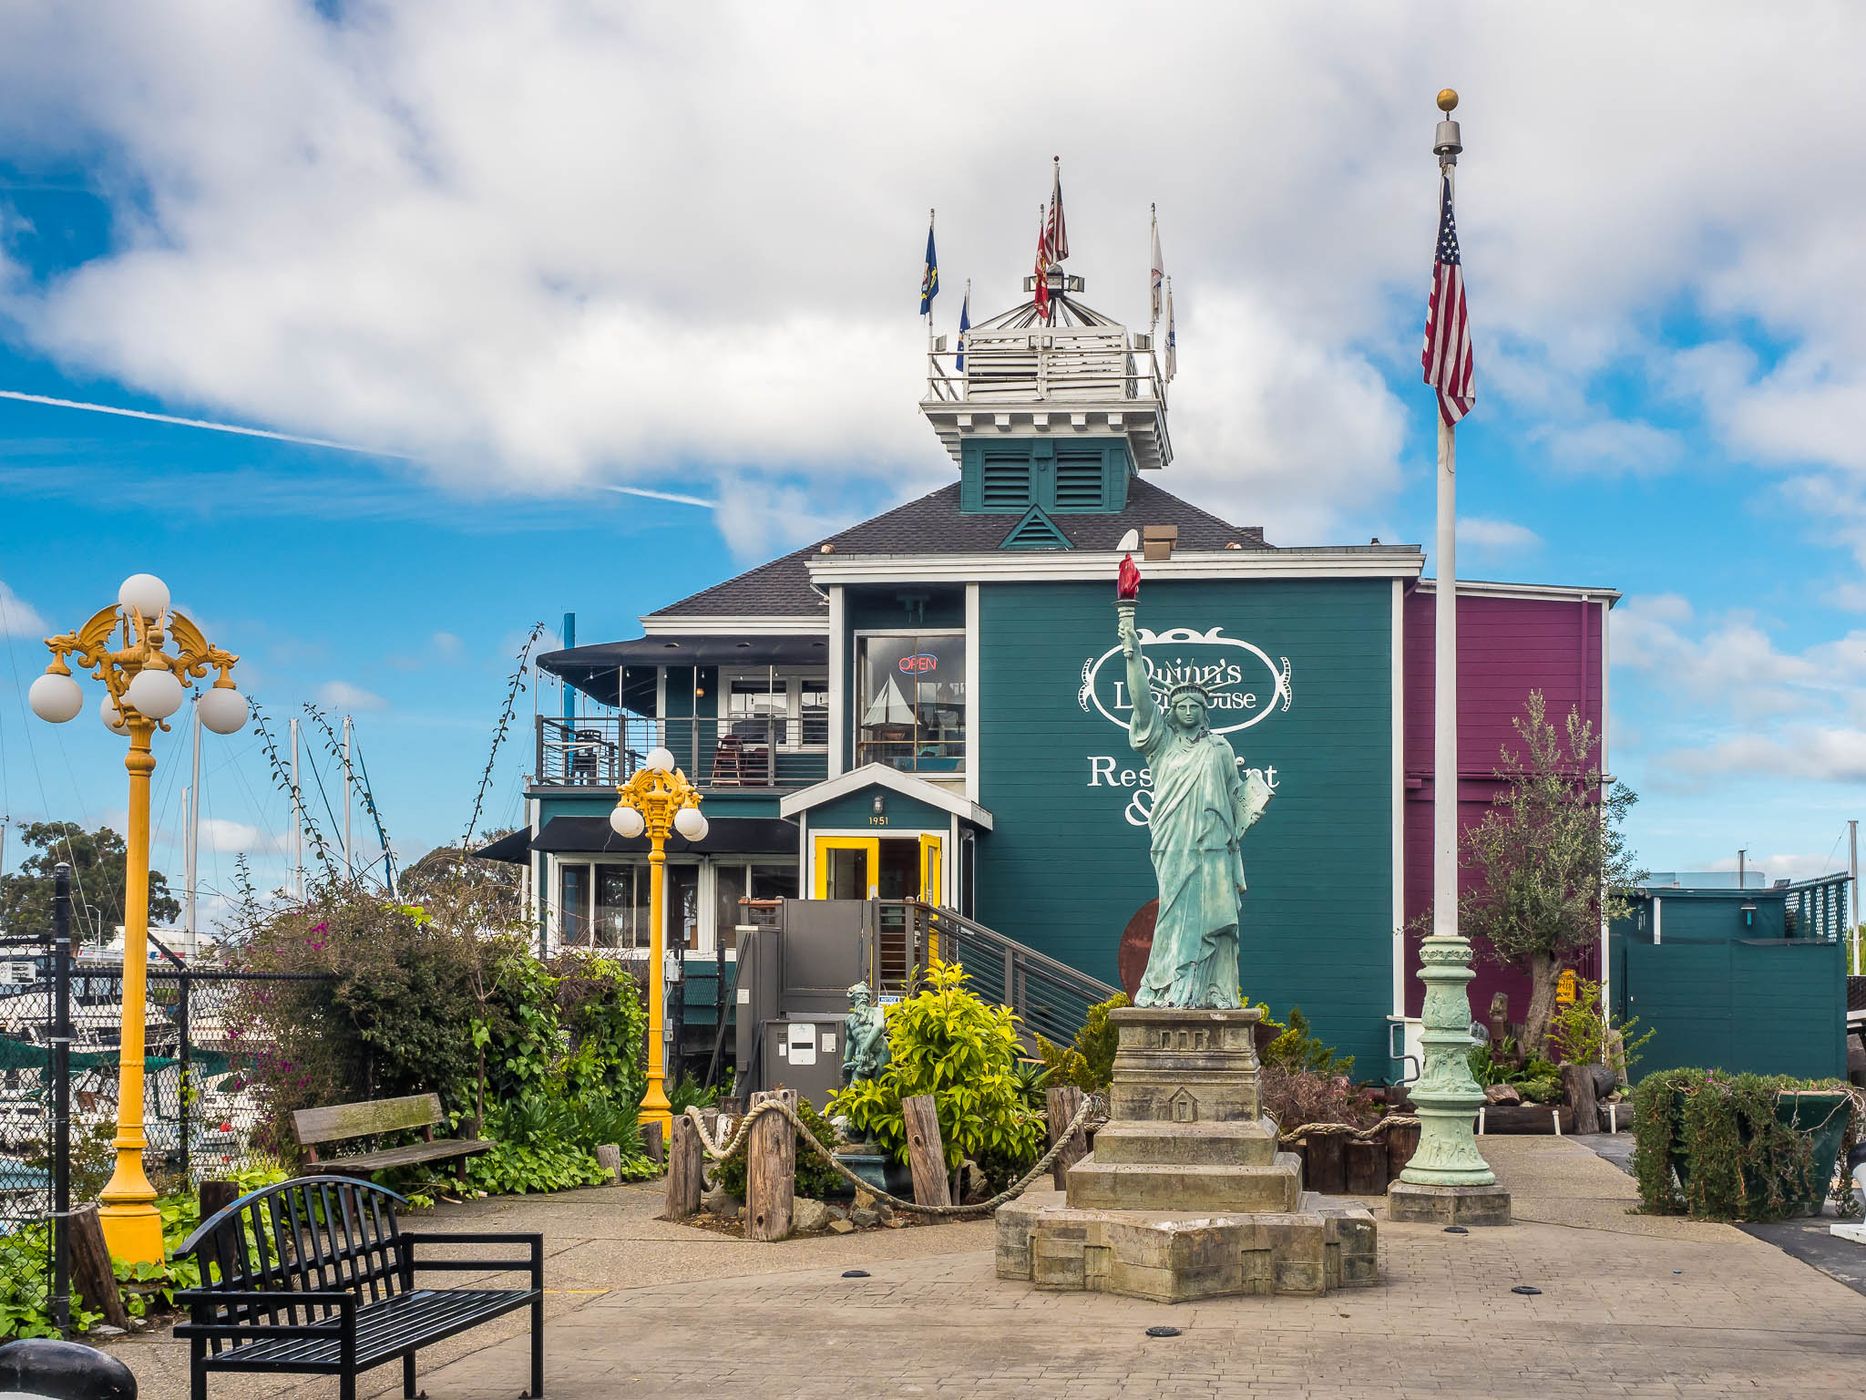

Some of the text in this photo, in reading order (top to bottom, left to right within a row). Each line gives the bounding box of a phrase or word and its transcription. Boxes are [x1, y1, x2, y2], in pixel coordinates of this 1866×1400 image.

[899, 657, 937, 671] OPEN
[1113, 681, 1256, 715] Lgouse
[1087, 756, 1280, 789] Resnt
[869, 816, 888, 825] 1951
[1124, 789, 1155, 826] &
